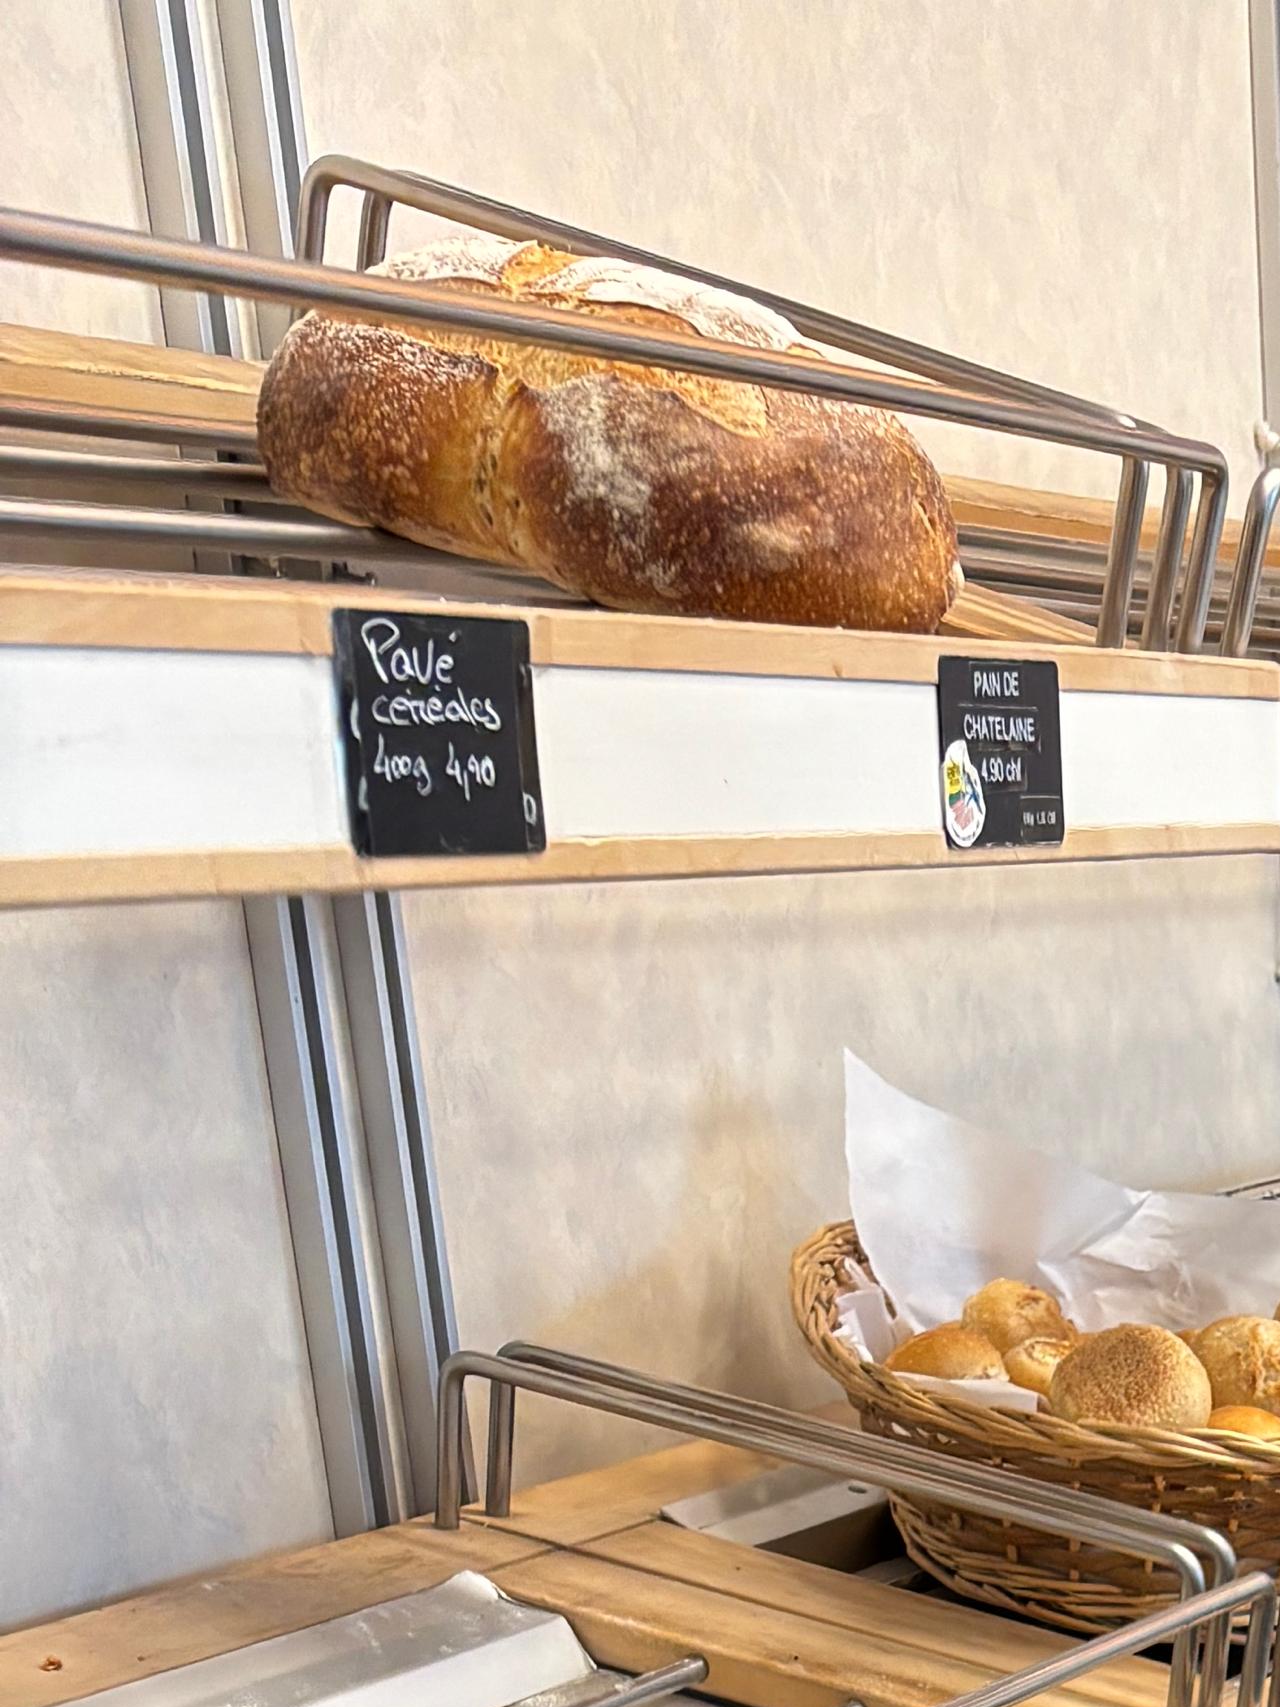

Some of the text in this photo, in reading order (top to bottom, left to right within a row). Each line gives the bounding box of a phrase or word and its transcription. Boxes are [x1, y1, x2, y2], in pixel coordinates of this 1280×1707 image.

[361, 617, 461, 685] Pavé
[973, 671, 1020, 698] PAIN DE
[963, 713, 1036, 742] CHATELAINE
[374, 733, 432, 797] 400g
[981, 756, 1004, 783] 4.90
